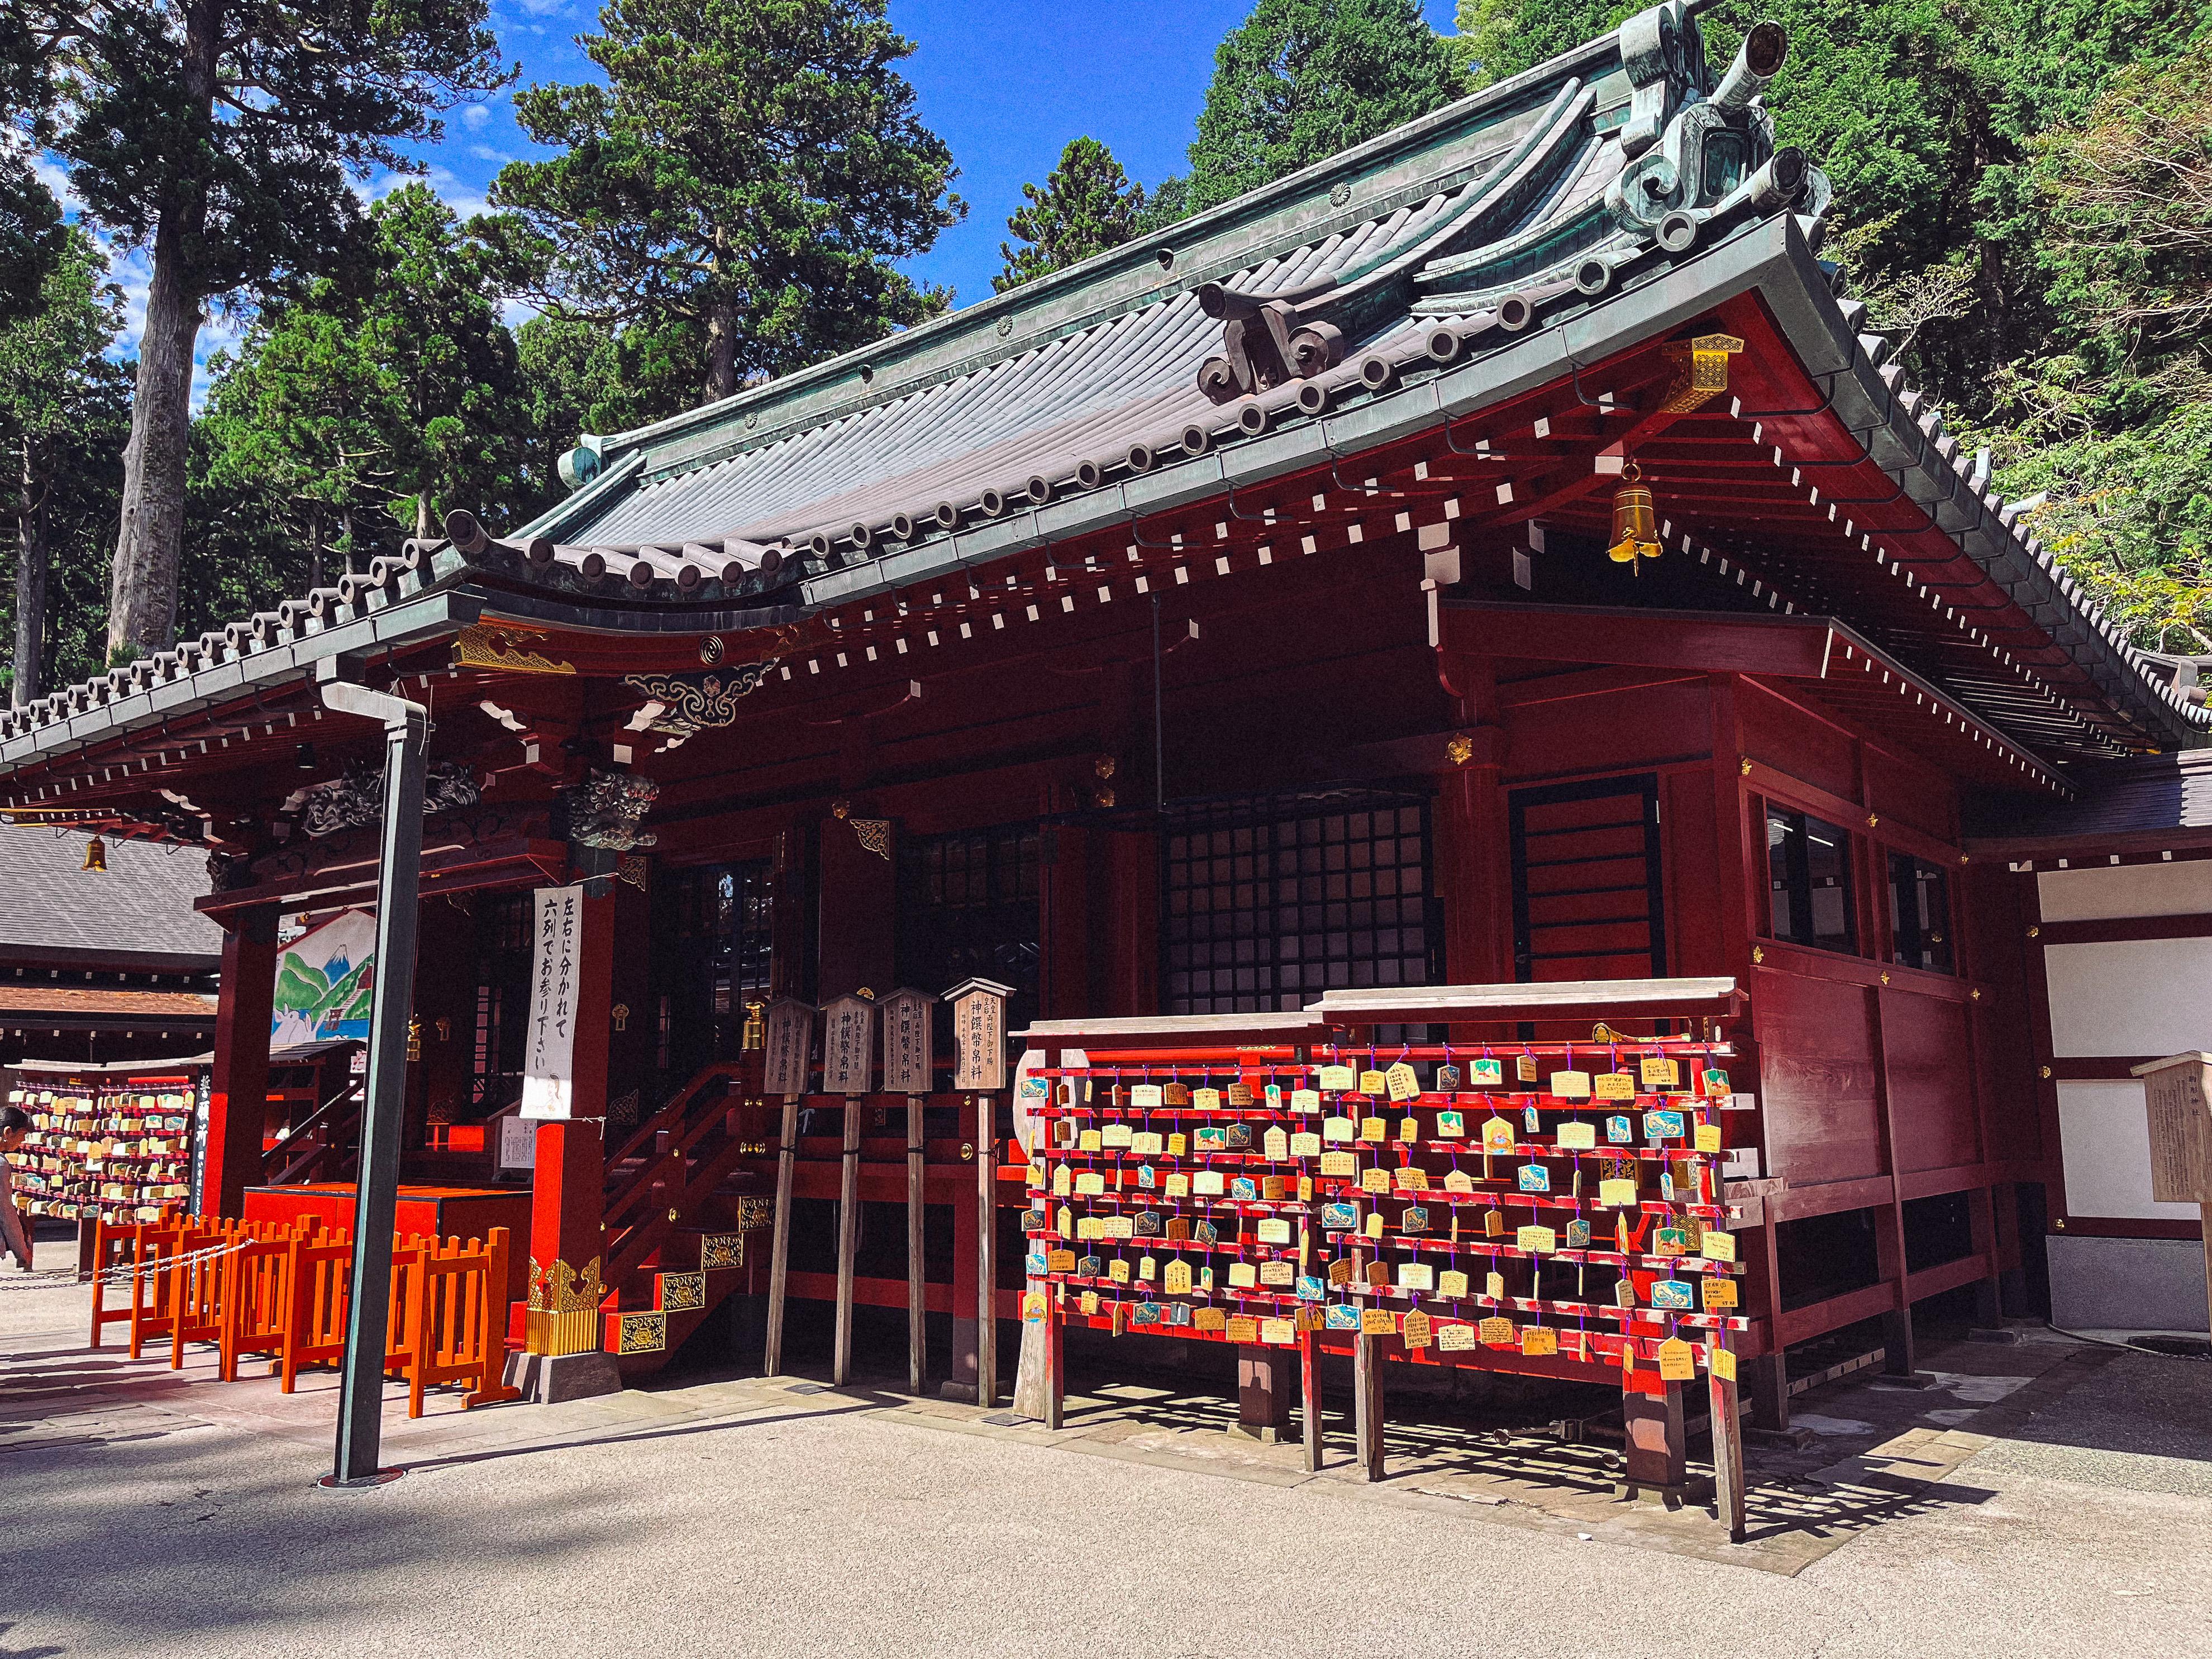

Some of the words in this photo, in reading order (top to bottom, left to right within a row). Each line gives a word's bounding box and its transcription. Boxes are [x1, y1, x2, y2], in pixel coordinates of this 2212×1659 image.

[535, 898, 558, 1070] 六列でお参り下さい
[555, 896, 575, 1038] 左右に分かれて
[971, 1000, 982, 1081] 神饌幣帛料
